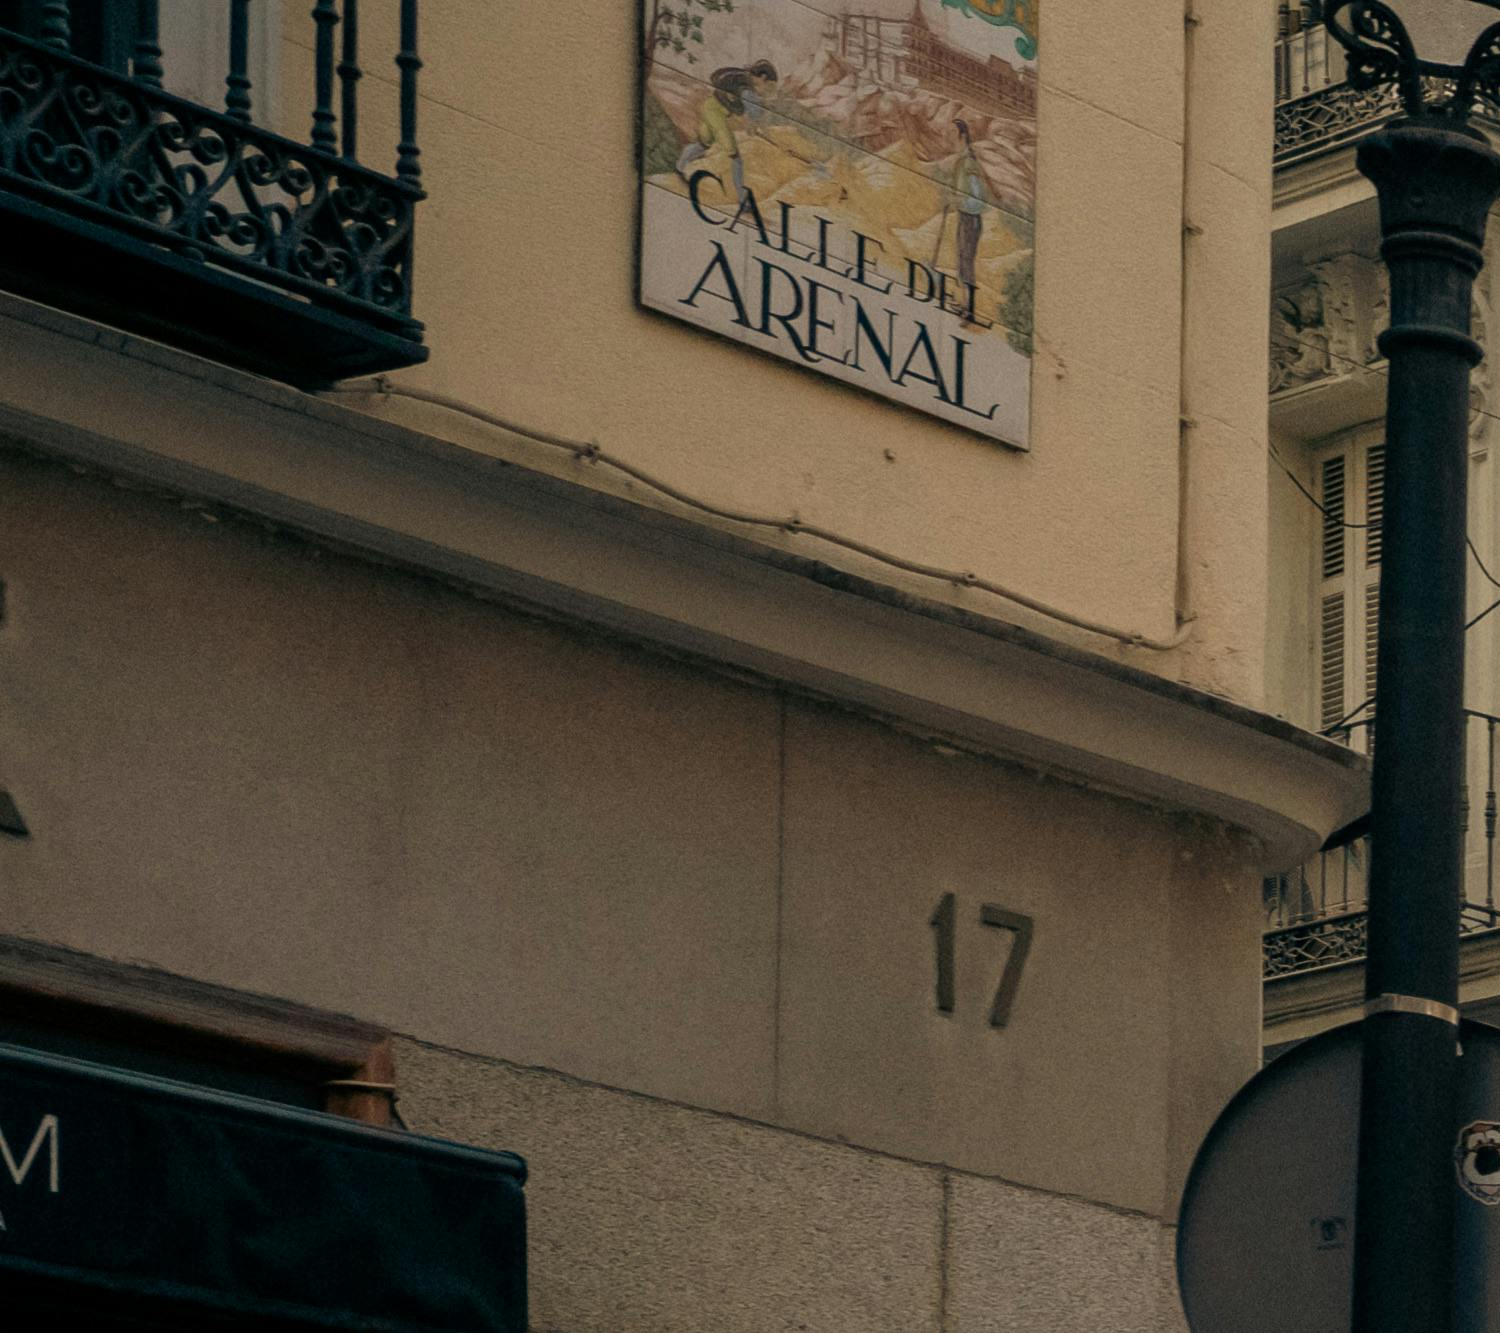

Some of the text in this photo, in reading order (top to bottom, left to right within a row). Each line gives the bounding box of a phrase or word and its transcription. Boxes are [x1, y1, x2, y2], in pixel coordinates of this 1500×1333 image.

[678, 240, 1000, 420] ARENAL
[689, 169, 993, 330] CALLE DEL
[930, 892, 1034, 1029] 17
